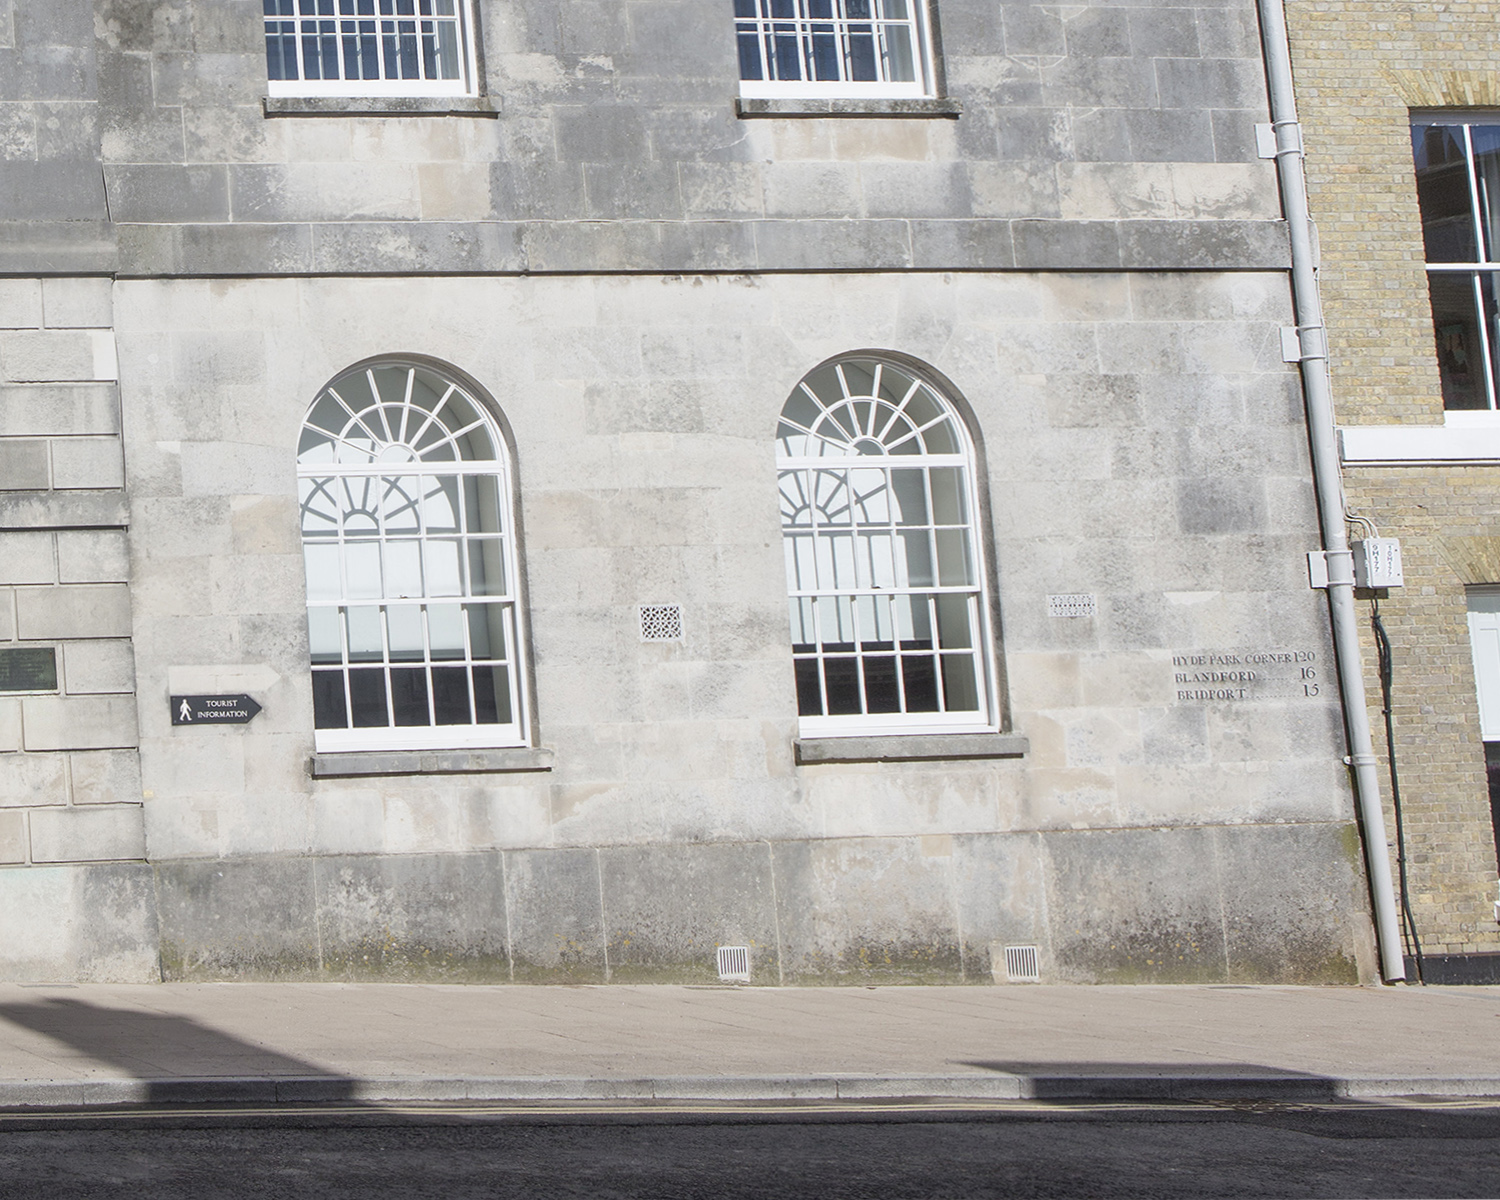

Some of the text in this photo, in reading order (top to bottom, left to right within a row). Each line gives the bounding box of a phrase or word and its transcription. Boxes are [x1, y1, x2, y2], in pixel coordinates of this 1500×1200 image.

[1172, 651, 1316, 667] HYDE PARK CORNER 120
[1175, 666, 1316, 684] BLANDFORD 16
[1177, 683, 1320, 701] BRIDPORT 15
[197, 710, 248, 719] INFORMATION
